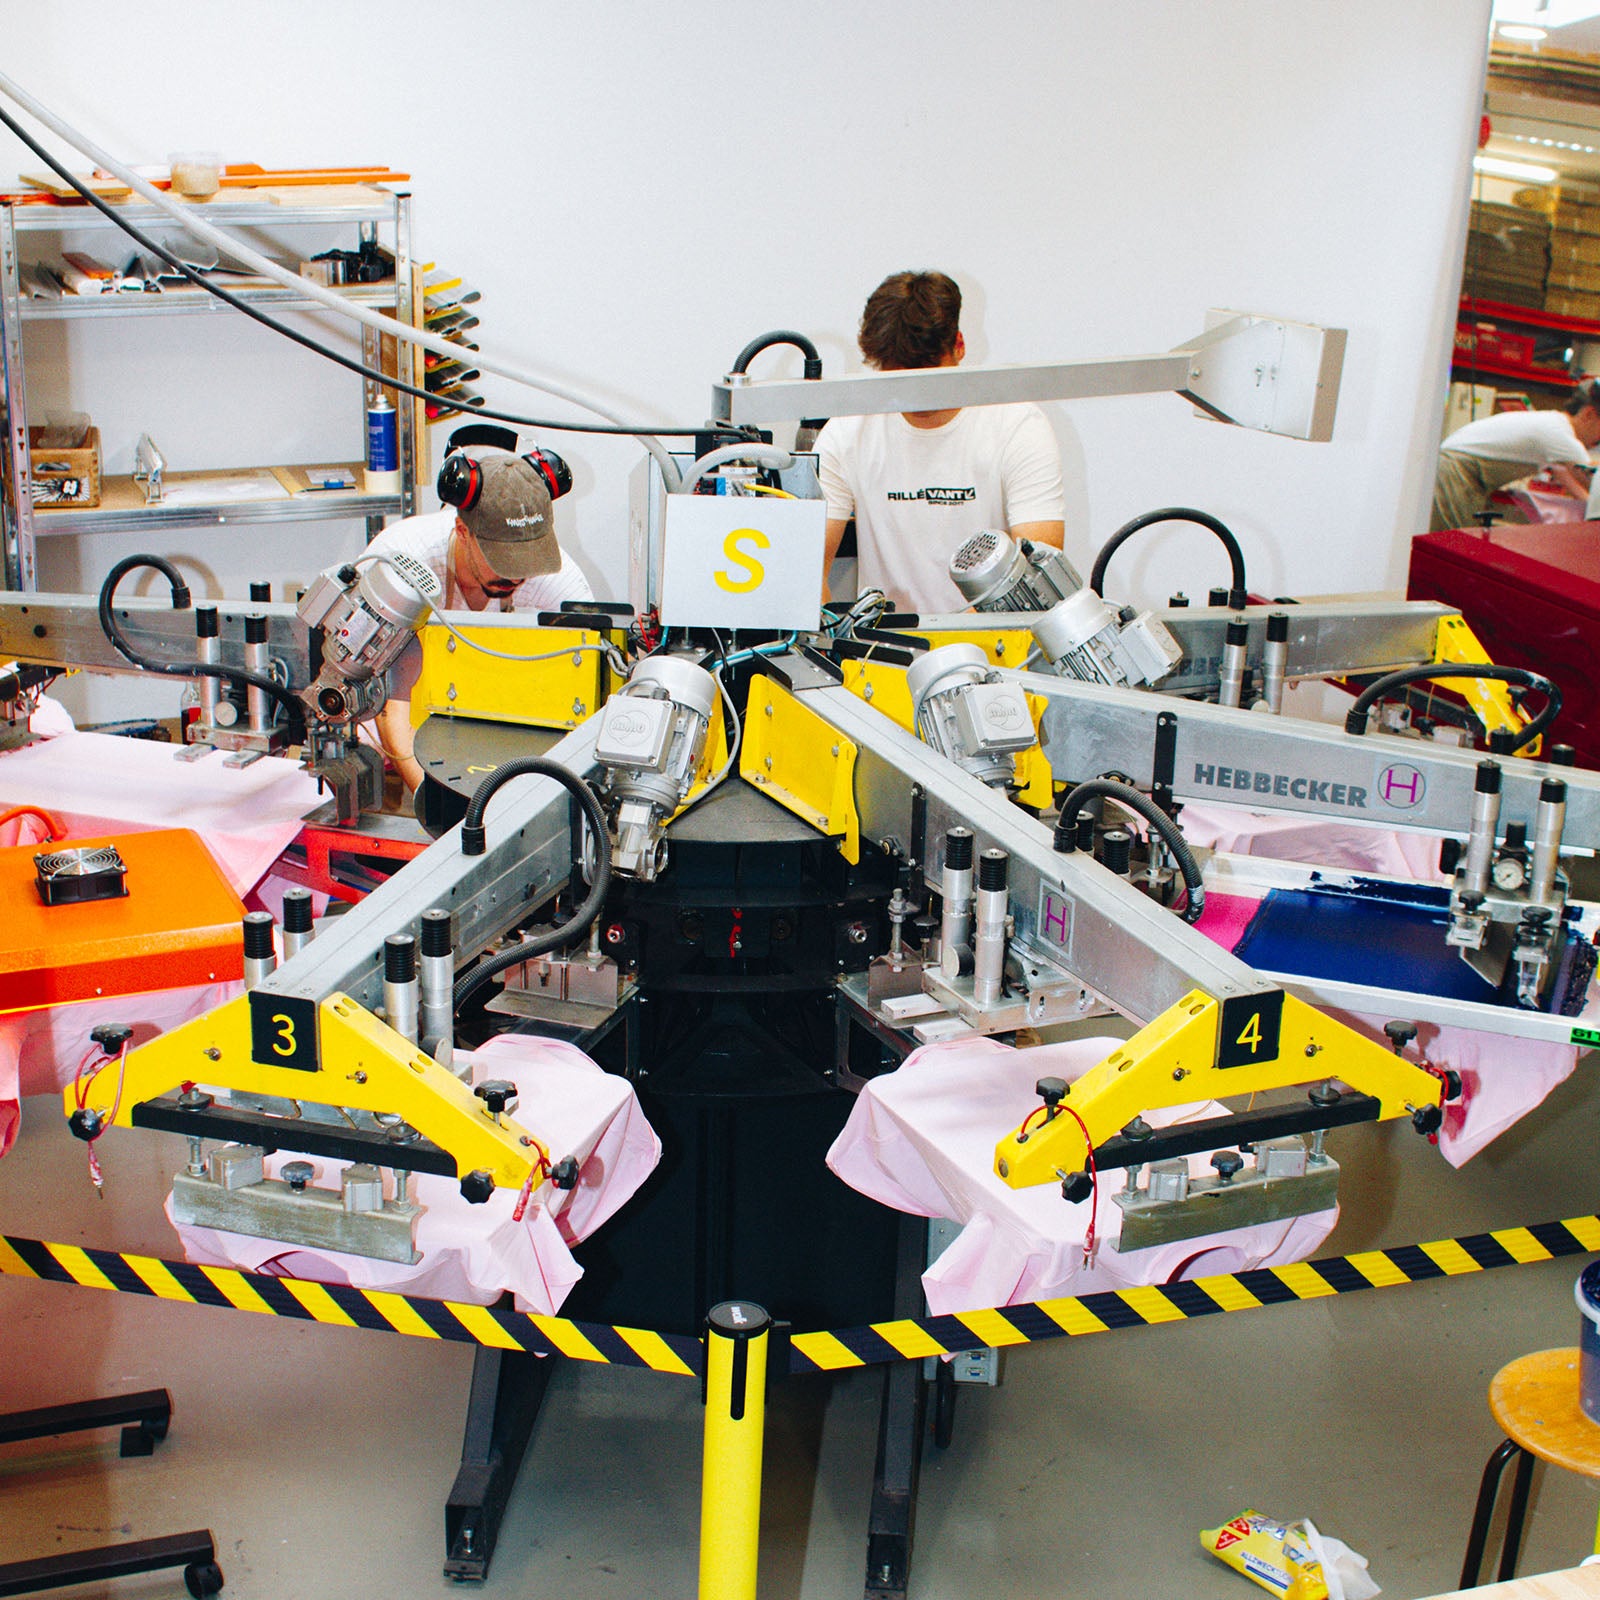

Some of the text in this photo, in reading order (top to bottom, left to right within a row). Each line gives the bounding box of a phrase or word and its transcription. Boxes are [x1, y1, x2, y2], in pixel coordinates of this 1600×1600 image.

[713, 528, 771, 594] S
[1194, 763, 1419, 809] HEBBECKER H
[1044, 895, 1067, 943] H
[272, 1013, 297, 1057] 3
[1235, 1012, 1263, 1054] 4
